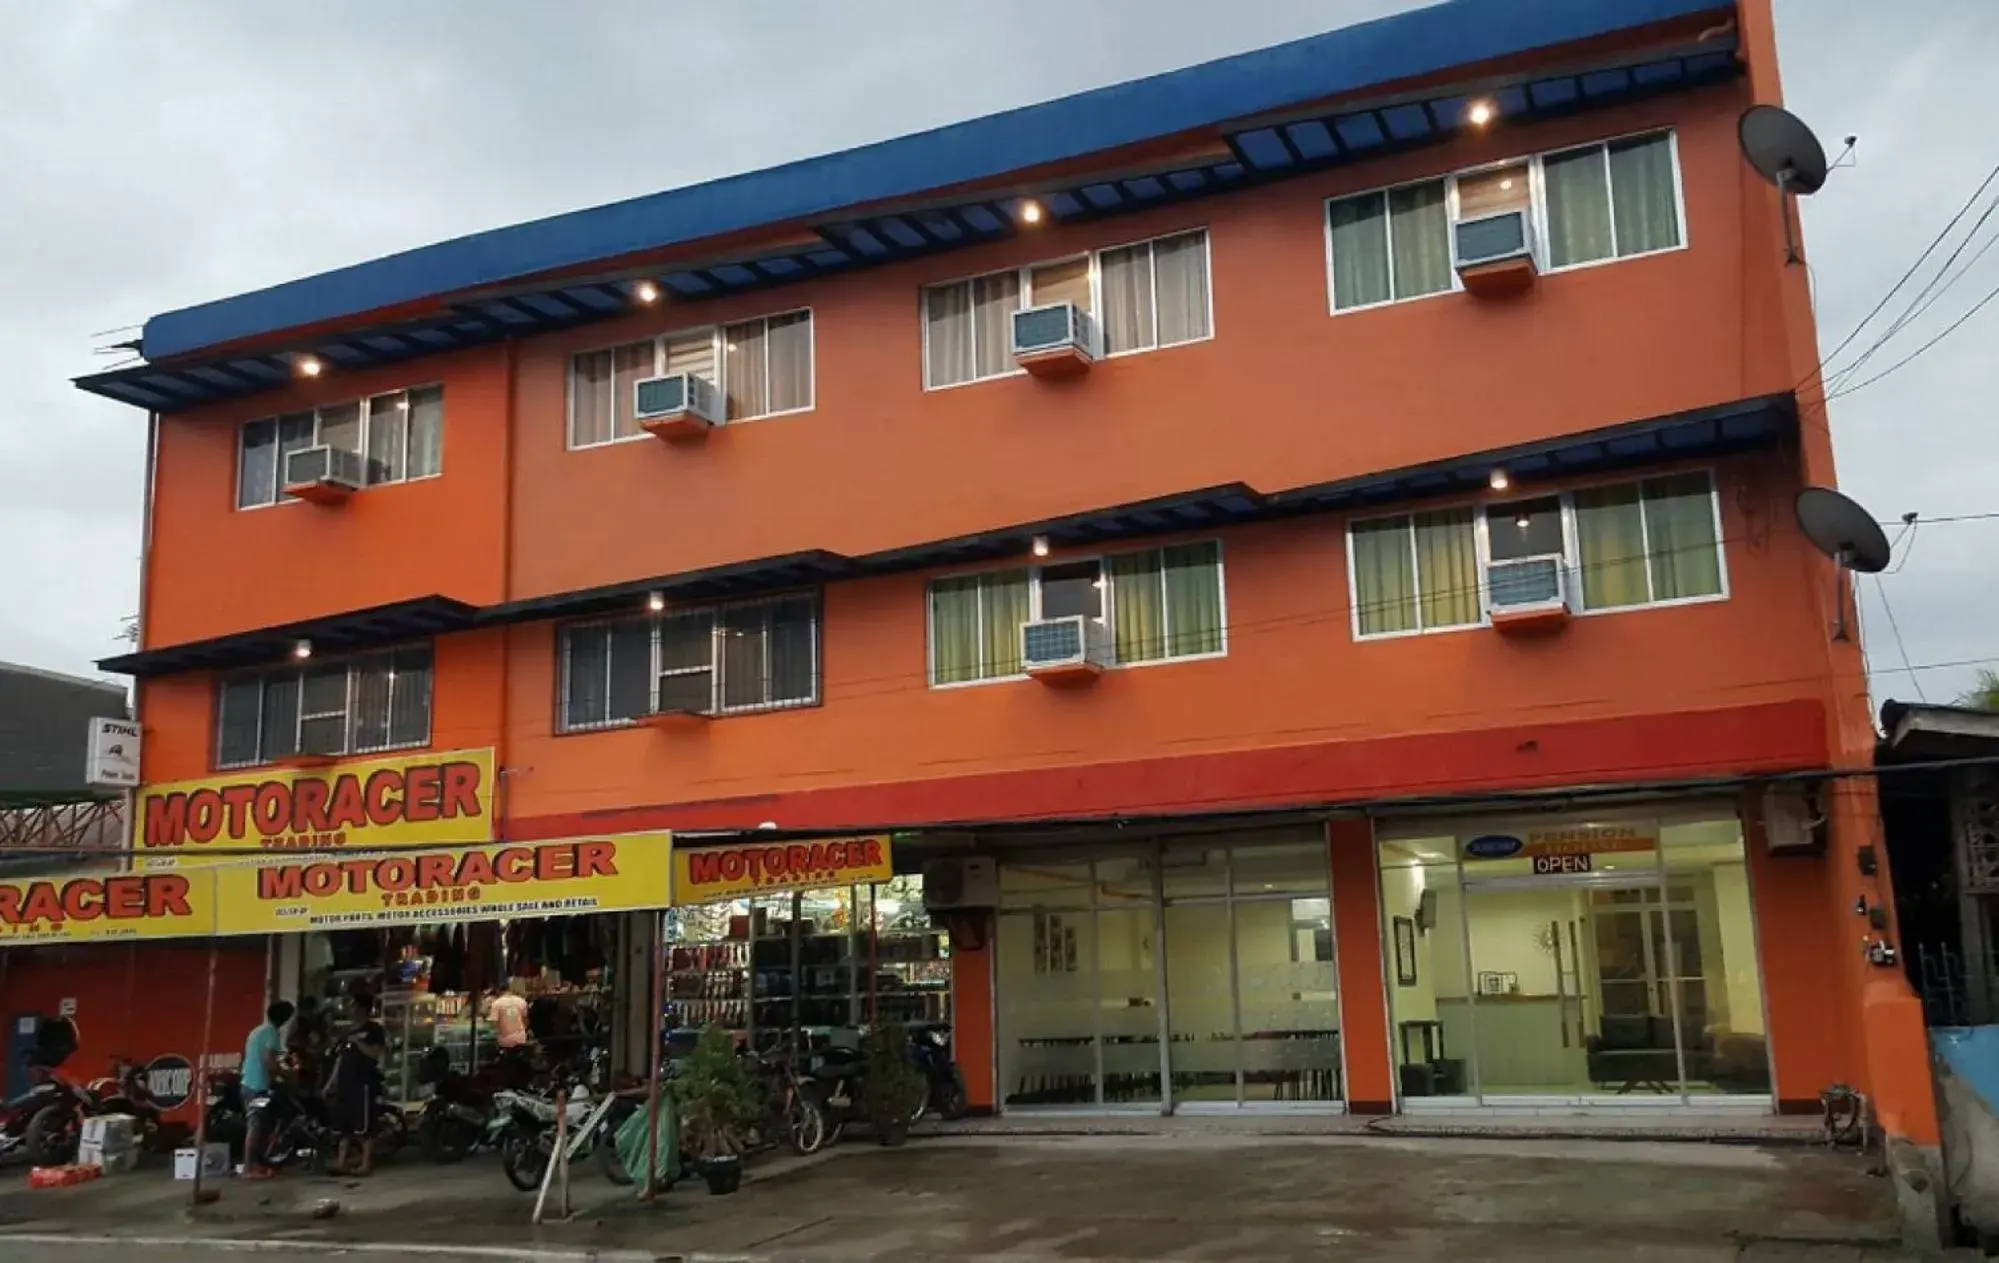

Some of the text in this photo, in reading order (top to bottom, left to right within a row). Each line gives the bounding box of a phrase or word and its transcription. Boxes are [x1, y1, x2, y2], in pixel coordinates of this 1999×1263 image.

[143, 761, 482, 848] MOTORACER
[260, 832, 347, 849] TRADING
[257, 841, 619, 899] MOTORACER
[689, 839, 882, 885] MOTORACER
[1537, 857, 1588, 873] OPEN
[381, 886, 481, 908] TRADING
